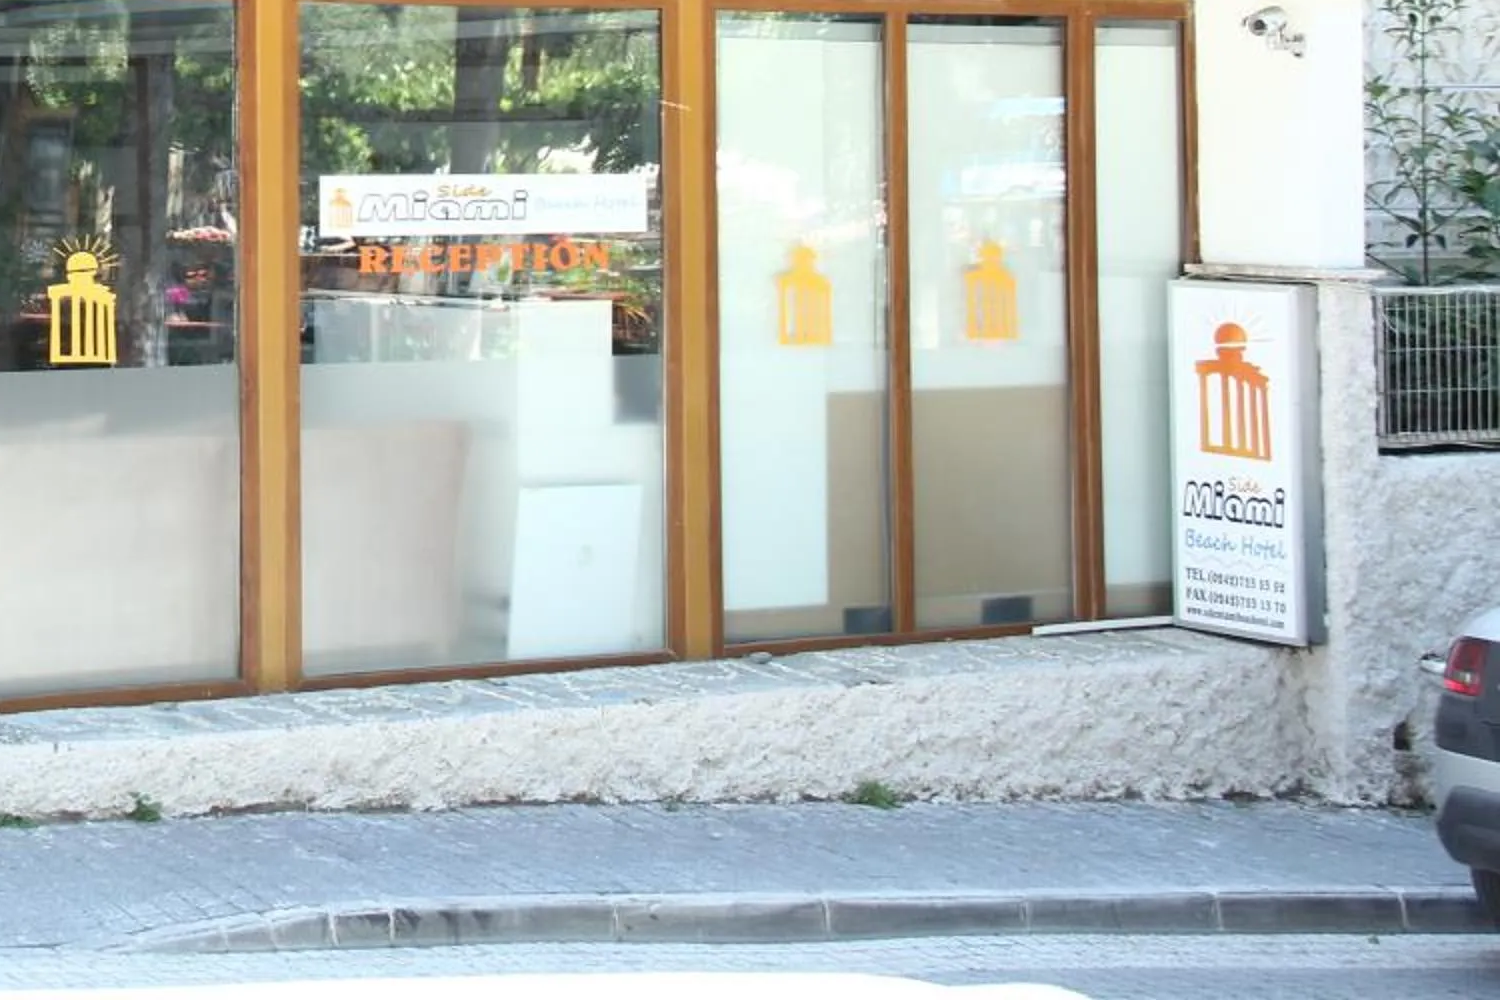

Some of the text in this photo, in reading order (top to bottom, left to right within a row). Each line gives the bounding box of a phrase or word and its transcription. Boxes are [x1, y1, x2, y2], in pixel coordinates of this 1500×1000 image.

[357, 189, 530, 222] Miami
[358, 241, 611, 274] RECEPTION
[1183, 480, 1285, 528] Miami
[1185, 528, 1287, 561] Beach Hotel
